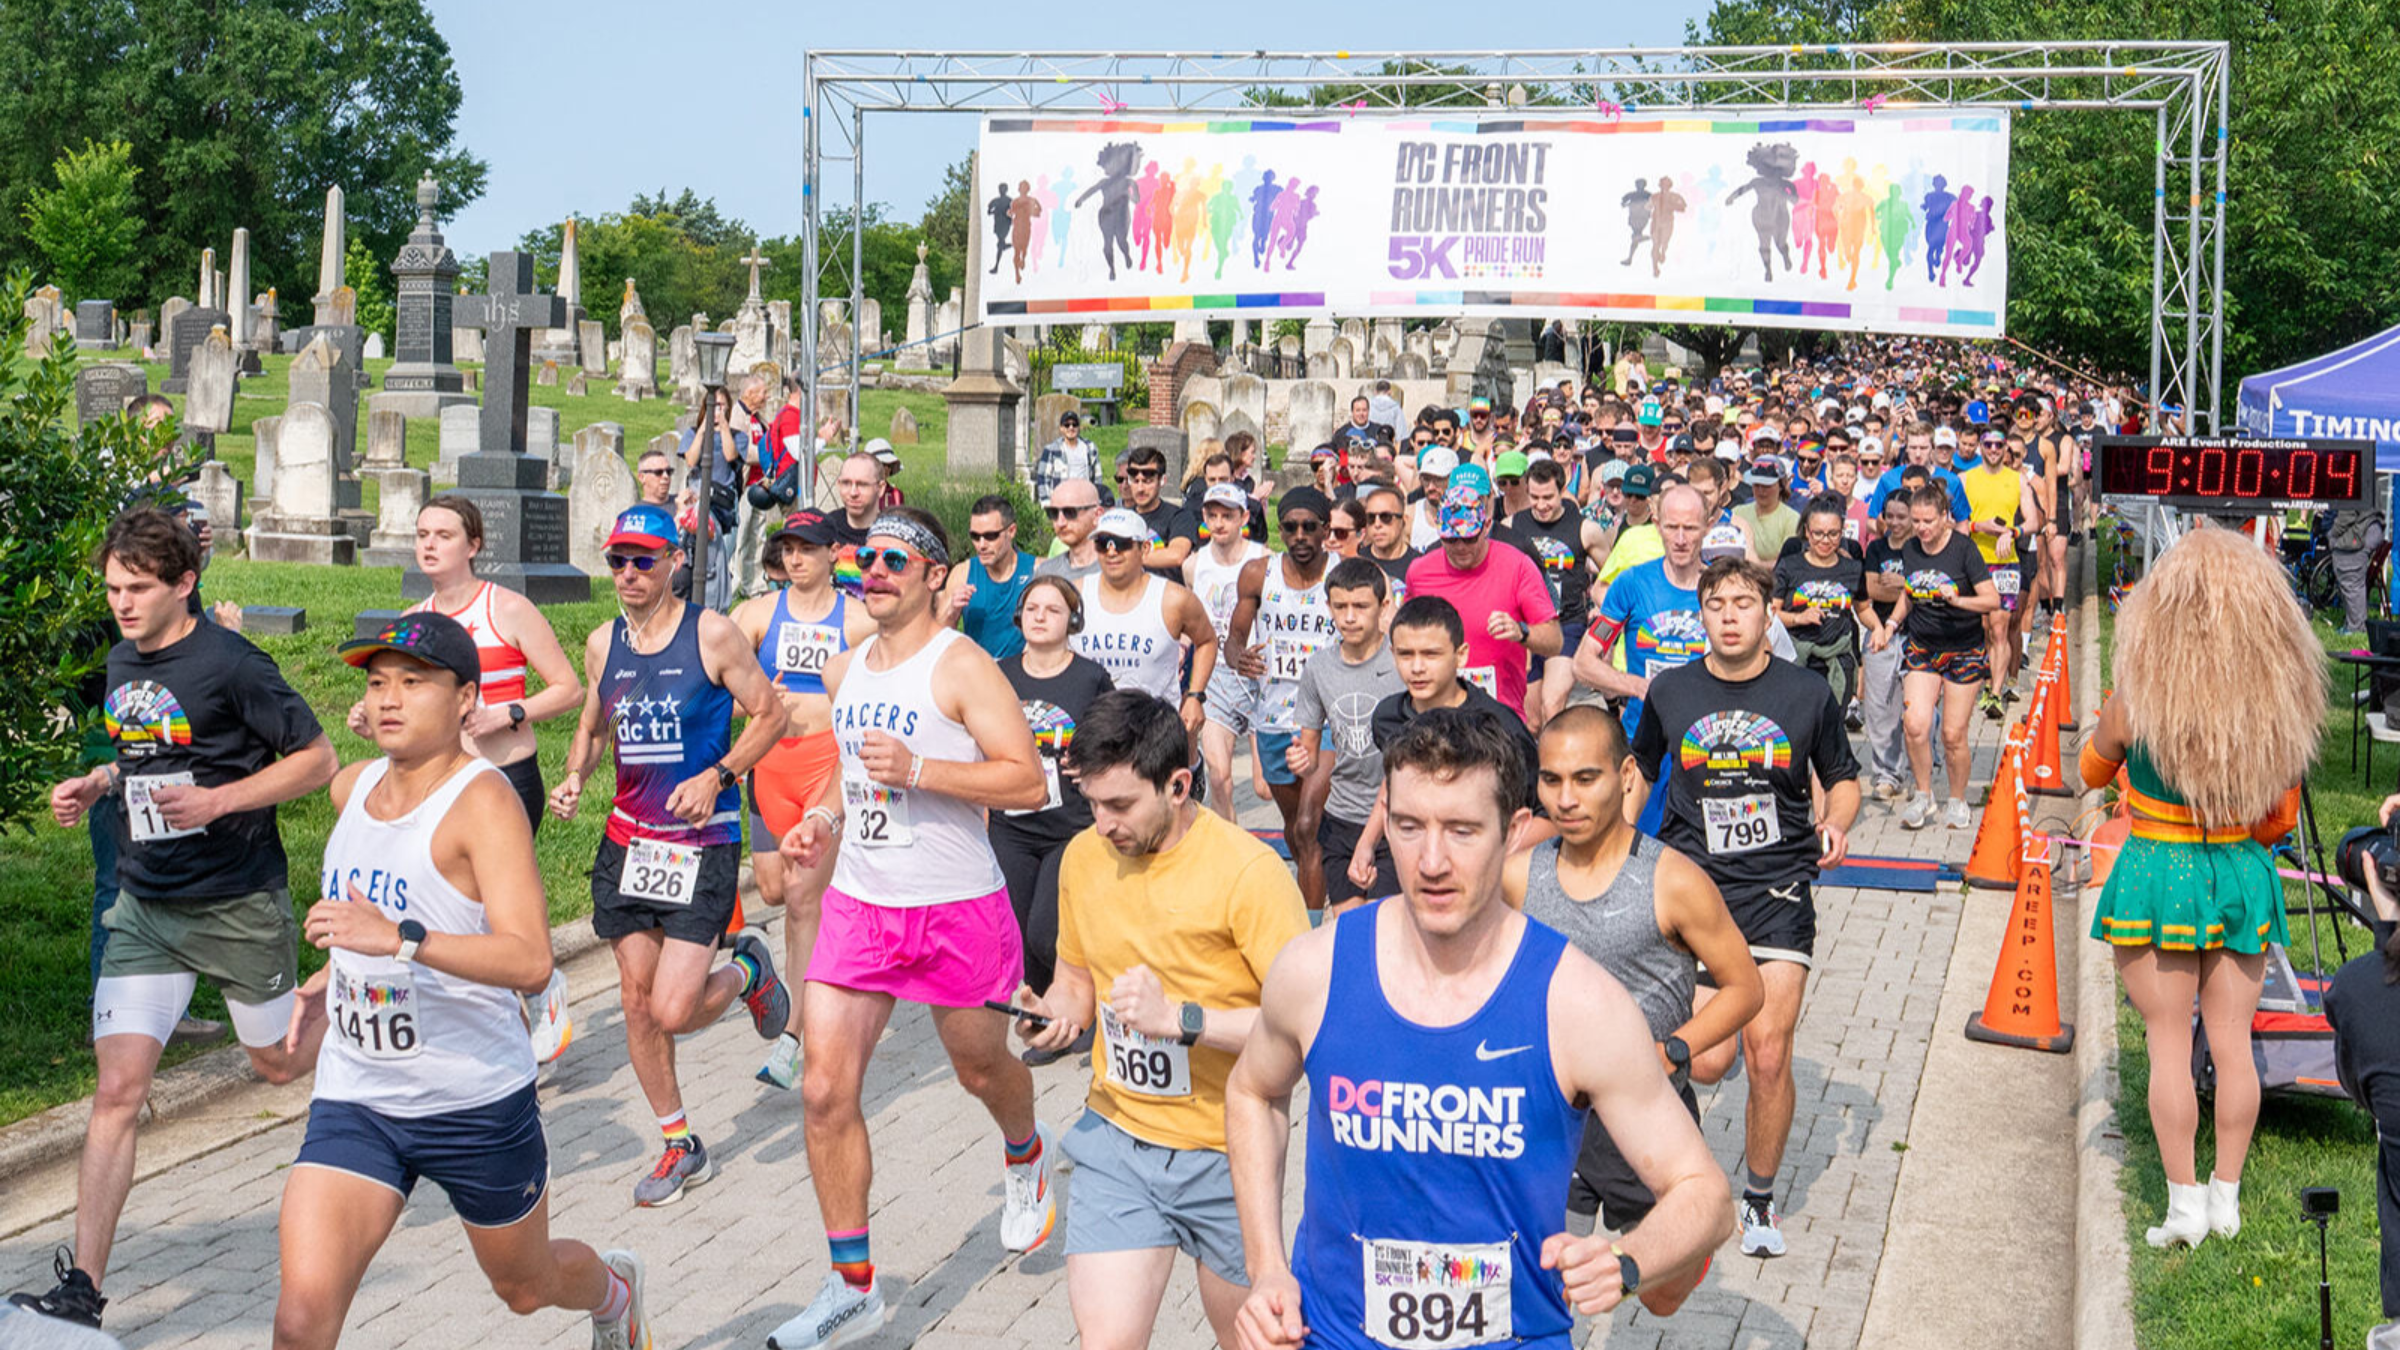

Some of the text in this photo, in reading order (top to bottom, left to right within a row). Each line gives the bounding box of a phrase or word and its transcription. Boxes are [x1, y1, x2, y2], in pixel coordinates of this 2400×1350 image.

[1395, 141, 1552, 185] DC FRONT
[1391, 187, 1547, 233] RUNNERS
[1388, 236, 1545, 280] 5K PRIDE RUN
[2160, 437, 2308, 449] ARE Event Productions
[1265, 613, 1336, 636] PACERS
[786, 645, 829, 670] 920
[1081, 632, 1153, 655] PACERS
[1092, 656, 1140, 668] UNNING
[617, 715, 682, 742] dc tri
[835, 703, 918, 737] PACERS
[860, 808, 889, 841] 32
[1717, 817, 1768, 848] 799
[321, 867, 408, 912] ACES
[632, 865, 684, 898] 326
[334, 1003, 416, 1052] 1416
[1112, 1042, 1173, 1090] 569
[1329, 1075, 1526, 1124] DCFRONT
[1330, 1110, 1525, 1159] RUNNERS
[1375, 1272, 1392, 1287] 5K
[817, 1297, 867, 1339] BROOKS
[1388, 1291, 1489, 1342] 894
